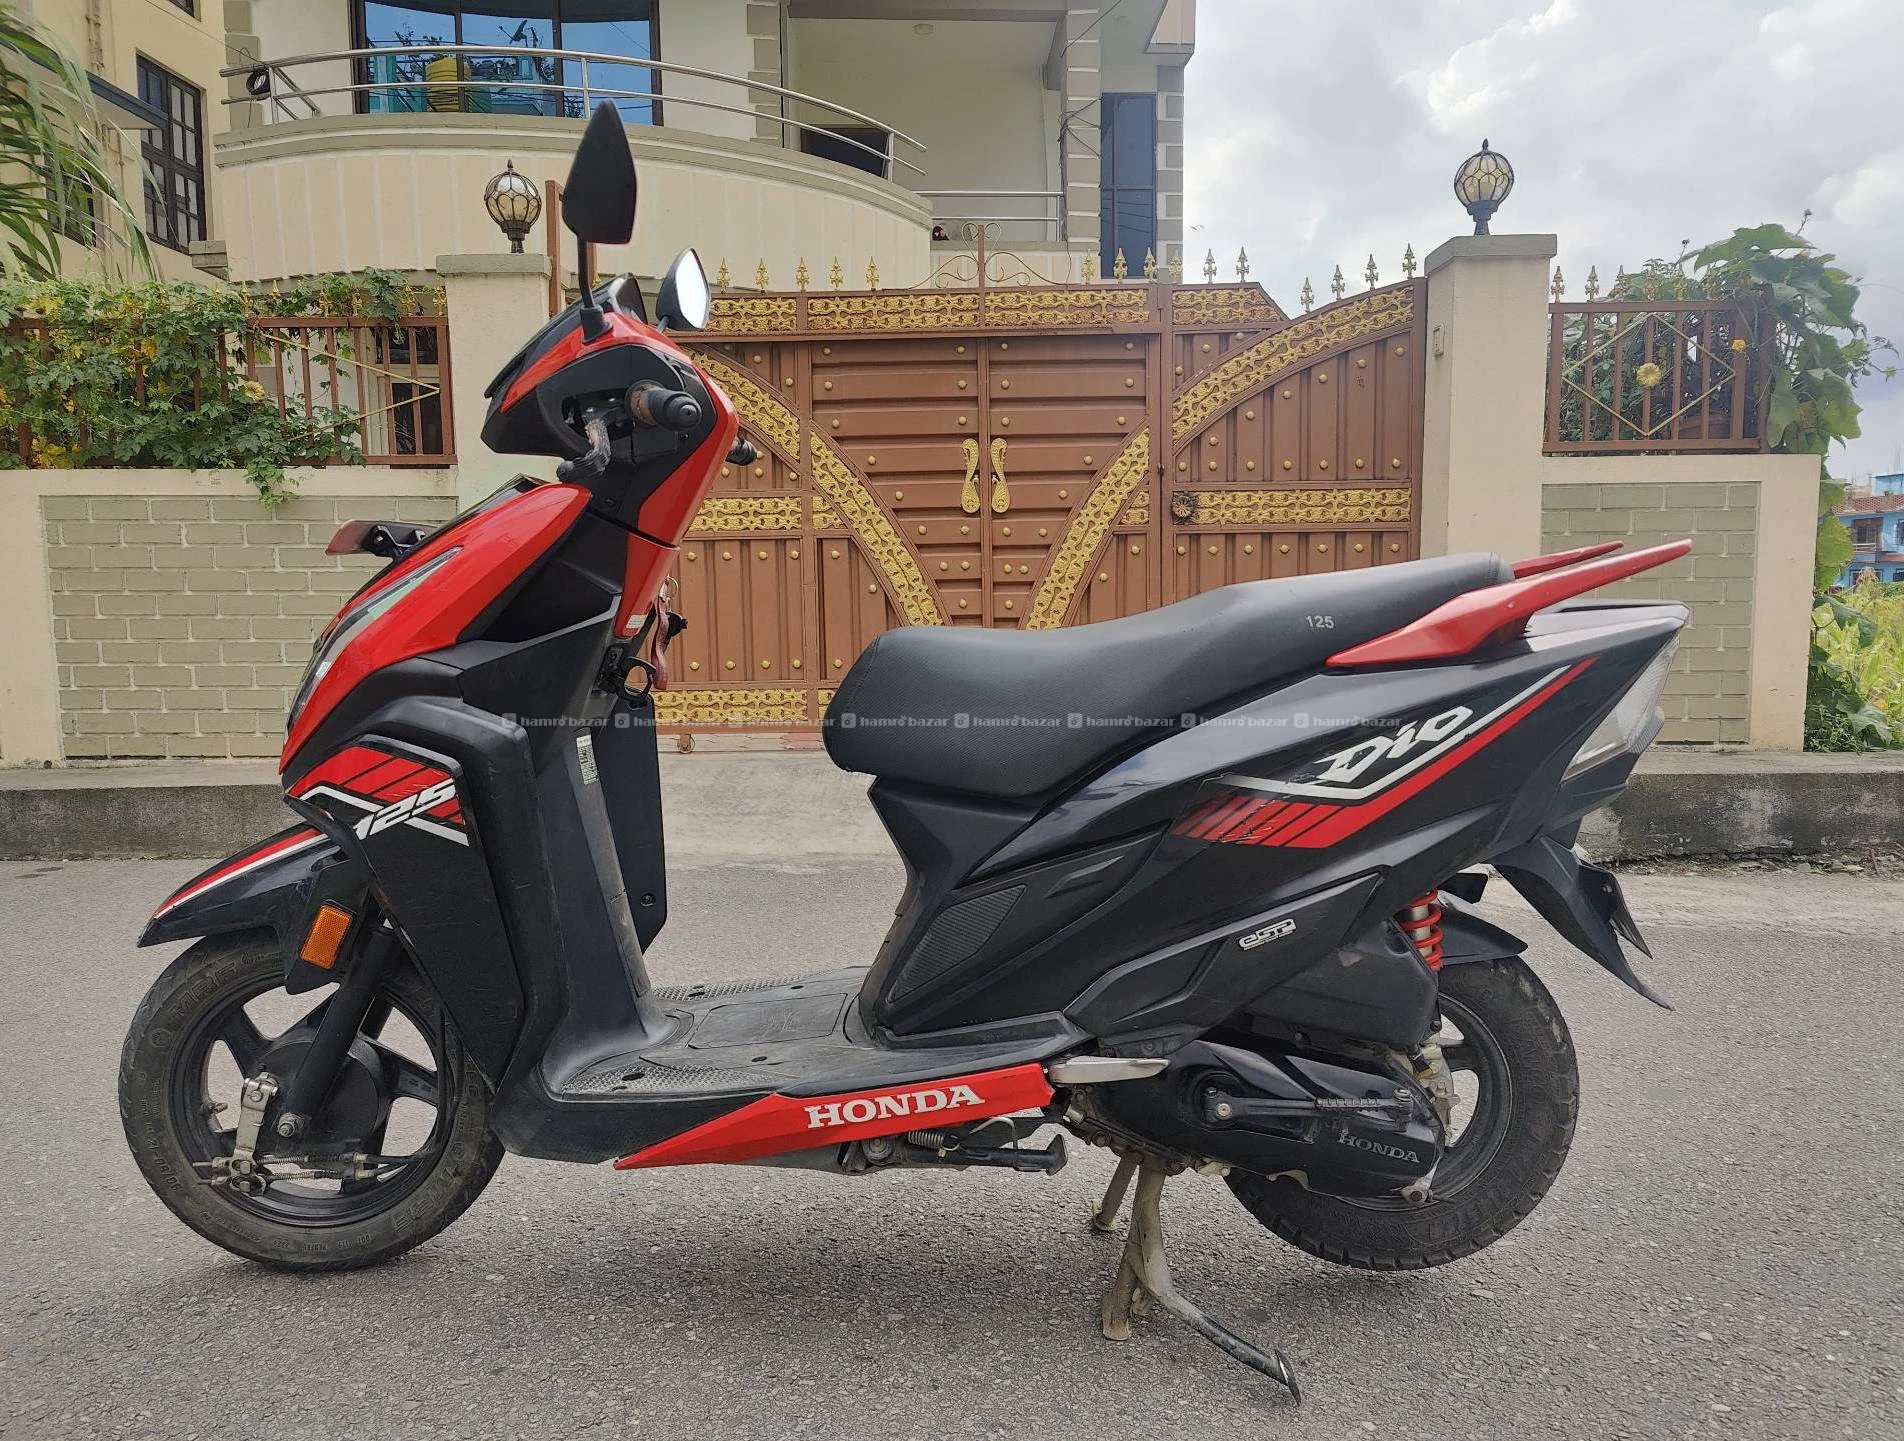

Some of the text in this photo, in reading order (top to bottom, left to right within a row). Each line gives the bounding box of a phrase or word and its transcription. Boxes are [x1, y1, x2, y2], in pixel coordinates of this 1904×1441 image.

[1305, 615, 1335, 629] 125
[353, 777, 456, 841] 125
[804, 1084, 986, 1129] HONDA
[1337, 1129, 1420, 1163] HONDA
